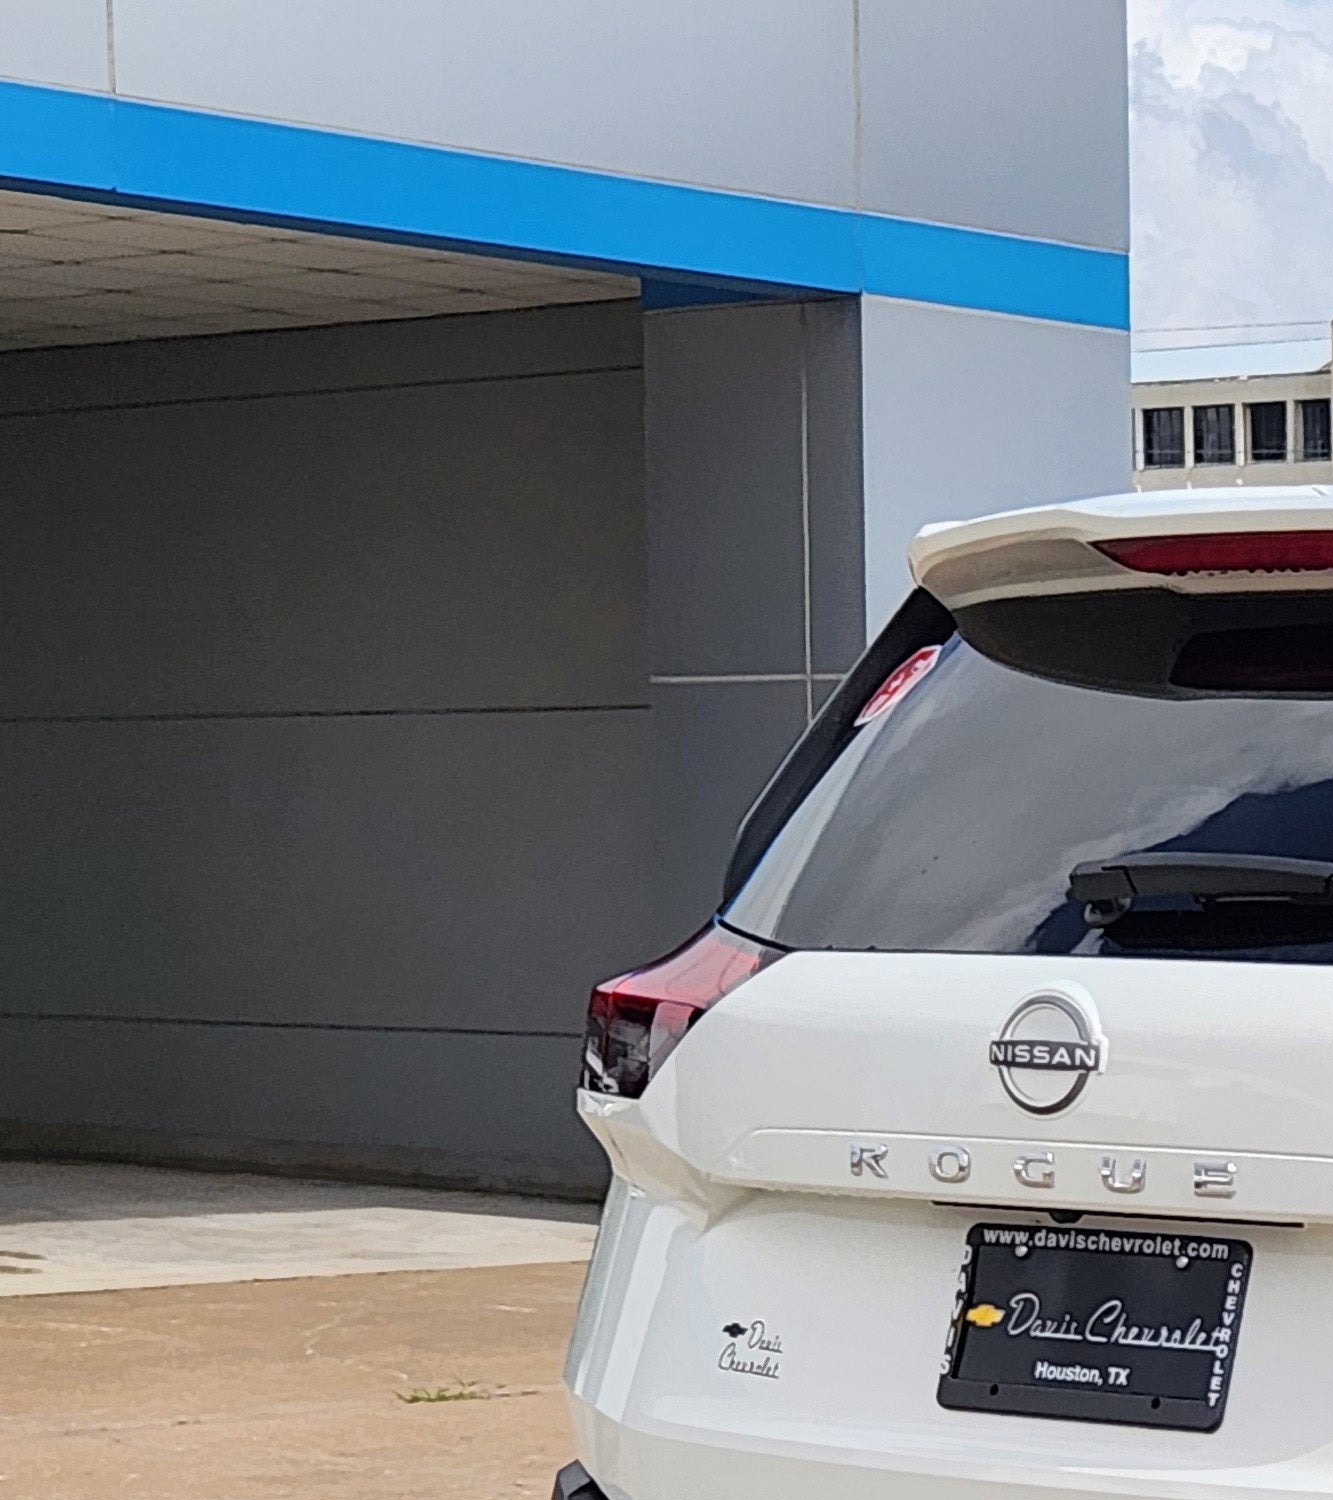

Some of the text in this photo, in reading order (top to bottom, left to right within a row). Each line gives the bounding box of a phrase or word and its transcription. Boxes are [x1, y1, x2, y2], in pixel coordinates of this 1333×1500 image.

[990, 1043, 1096, 1067] NISSAN
[850, 1143, 1236, 1199] ROGUE
[983, 1228, 1229, 1259] www.davischevrolet.com
[1006, 1293, 1223, 1352] Davis Chevrolet
[1207, 1262, 1244, 1408] CHEVROLET
[1034, 1361, 1130, 1386] Houston, TX
